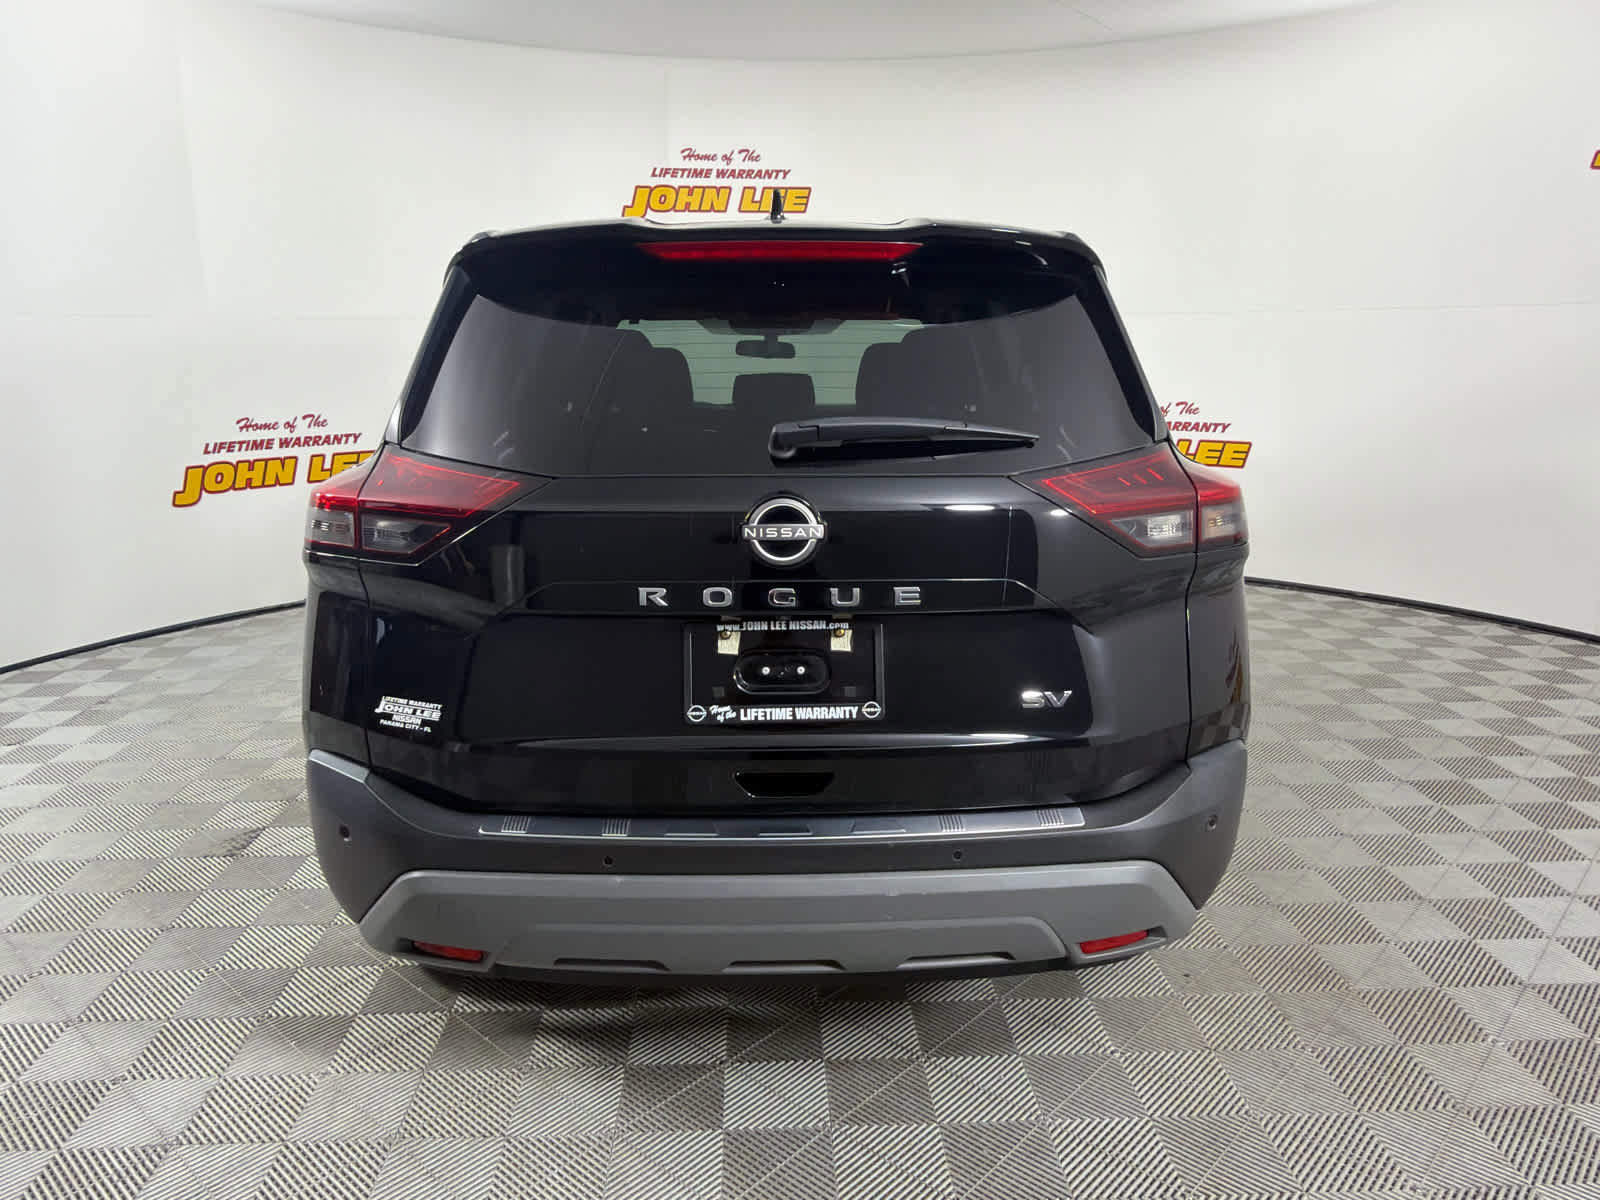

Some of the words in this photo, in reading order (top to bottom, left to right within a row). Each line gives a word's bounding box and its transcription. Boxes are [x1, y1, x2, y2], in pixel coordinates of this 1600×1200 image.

[680, 147, 718, 162] Home
[721, 149, 735, 165] of
[738, 148, 761, 162] The
[651, 167, 713, 179] LIFETIME
[715, 168, 791, 180] WARRANTY
[622, 185, 731, 217] JOHN
[1175, 400, 1200, 415] The
[236, 417, 280, 432] Home
[283, 416, 298, 432] of
[301, 413, 328, 428] The
[203, 438, 275, 455] LIFETIME
[278, 432, 362, 449] WARRANTY
[1176, 438, 1253, 469] LEE
[172, 456, 298, 508] JOHN
[306, 450, 377, 483] LE
[744, 527, 821, 538] NISSAN
[638, 586, 921, 607] ROGUE
[770, 620, 787, 631] LEE
[1021, 690, 1072, 710] SV
[374, 699, 414, 715] JOHN
[415, 707, 442, 721] LEE
[740, 707, 793, 720] LIFETIME
[795, 705, 859, 719] WARRANTY
[379, 719, 404, 728] PANAMA
[392, 714, 422, 726] NISSAN
